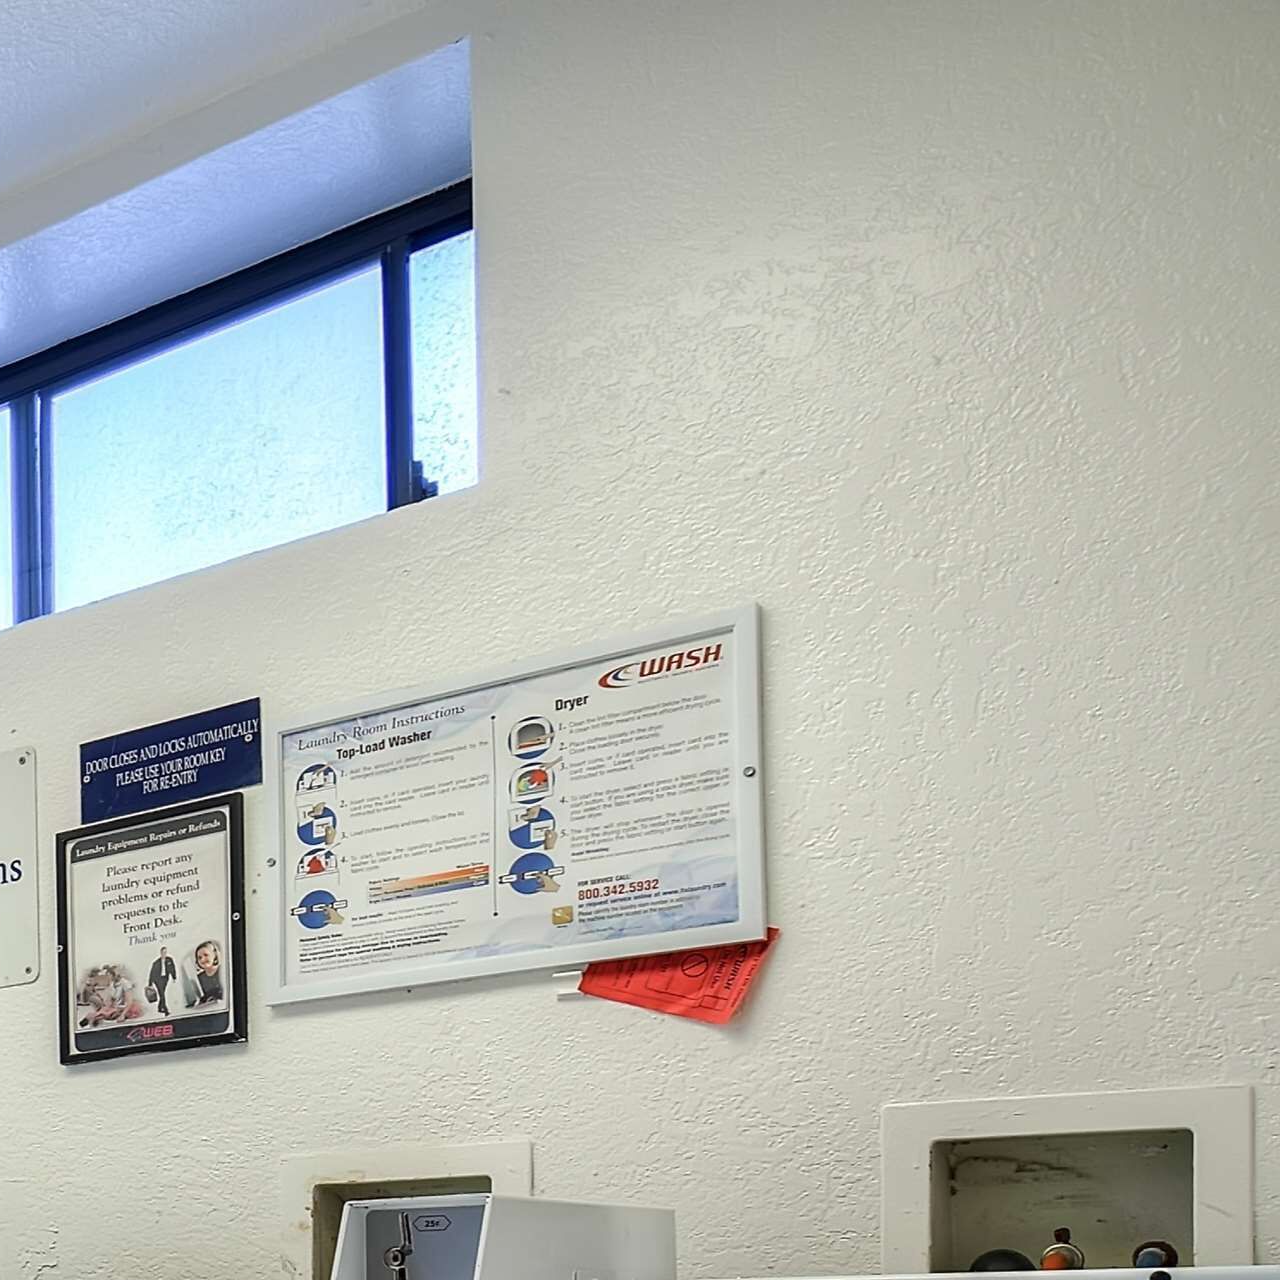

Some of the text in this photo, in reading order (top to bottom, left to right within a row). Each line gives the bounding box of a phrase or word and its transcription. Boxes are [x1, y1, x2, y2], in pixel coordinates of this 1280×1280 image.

[640, 643, 723, 678] WASH
[555, 695, 590, 712] Dryer
[298, 704, 466, 751] Laundry Room Instructions
[85, 718, 260, 775] DOOR CLOSES AND LOCKS AUTOMATICALLY
[336, 729, 433, 760] Top-Load Washer
[116, 747, 227, 787] PLEASE USE YOUR ROOM KEY
[143, 769, 199, 795] FOR RE-ENTRY
[76, 844, 106, 858] Laundry
[107, 835, 149, 851] Equipment
[149, 830, 177, 842] Repairs
[187, 818, 221, 834] Refunds
[106, 852, 194, 877] Please report any
[102, 866, 199, 893] laundry equipment
[578, 878, 660, 901] 800.342.5932
[590, 876, 614, 885] SERVICE
[101, 880, 200, 910] problems or refund
[114, 899, 189, 921] requests to the
[123, 914, 182, 934] Front Desk.
[128, 931, 177, 946] Thank you
